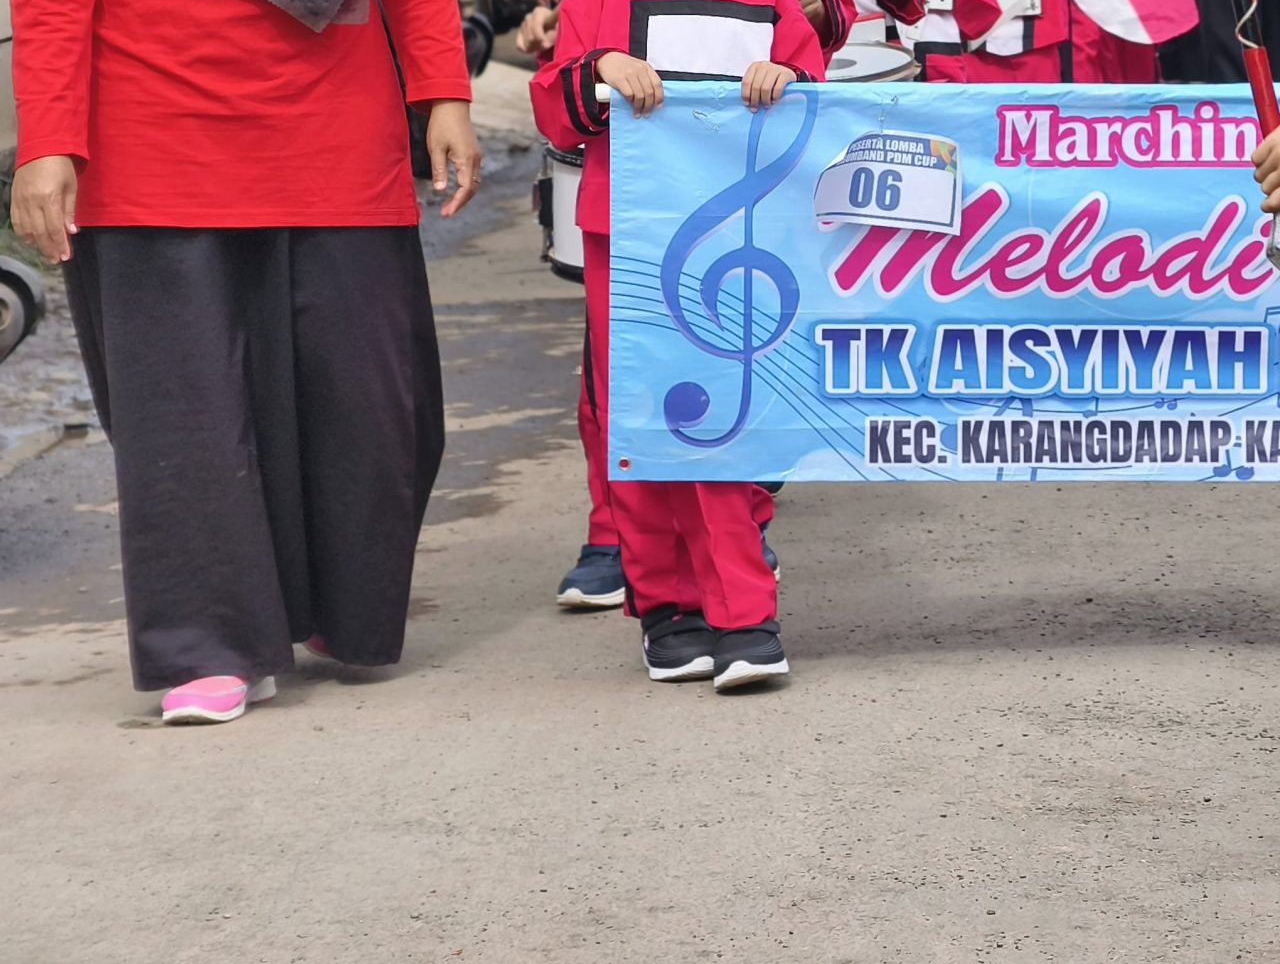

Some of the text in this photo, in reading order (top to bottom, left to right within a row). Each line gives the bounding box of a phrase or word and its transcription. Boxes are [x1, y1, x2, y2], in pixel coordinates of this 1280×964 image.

[848, 137, 925, 155] PESERTA LOMBA
[999, 104, 1264, 164] Marchin
[886, 151, 912, 165] PDM
[914, 154, 939, 168] CUP
[848, 166, 904, 212] 06
[822, 186, 1276, 298] Melodi
[821, 328, 909, 391] TK
[934, 328, 1263, 391] AISYIYAH
[867, 419, 948, 464] KEC.
[960, 419, 1232, 464] KARANGDADAP
